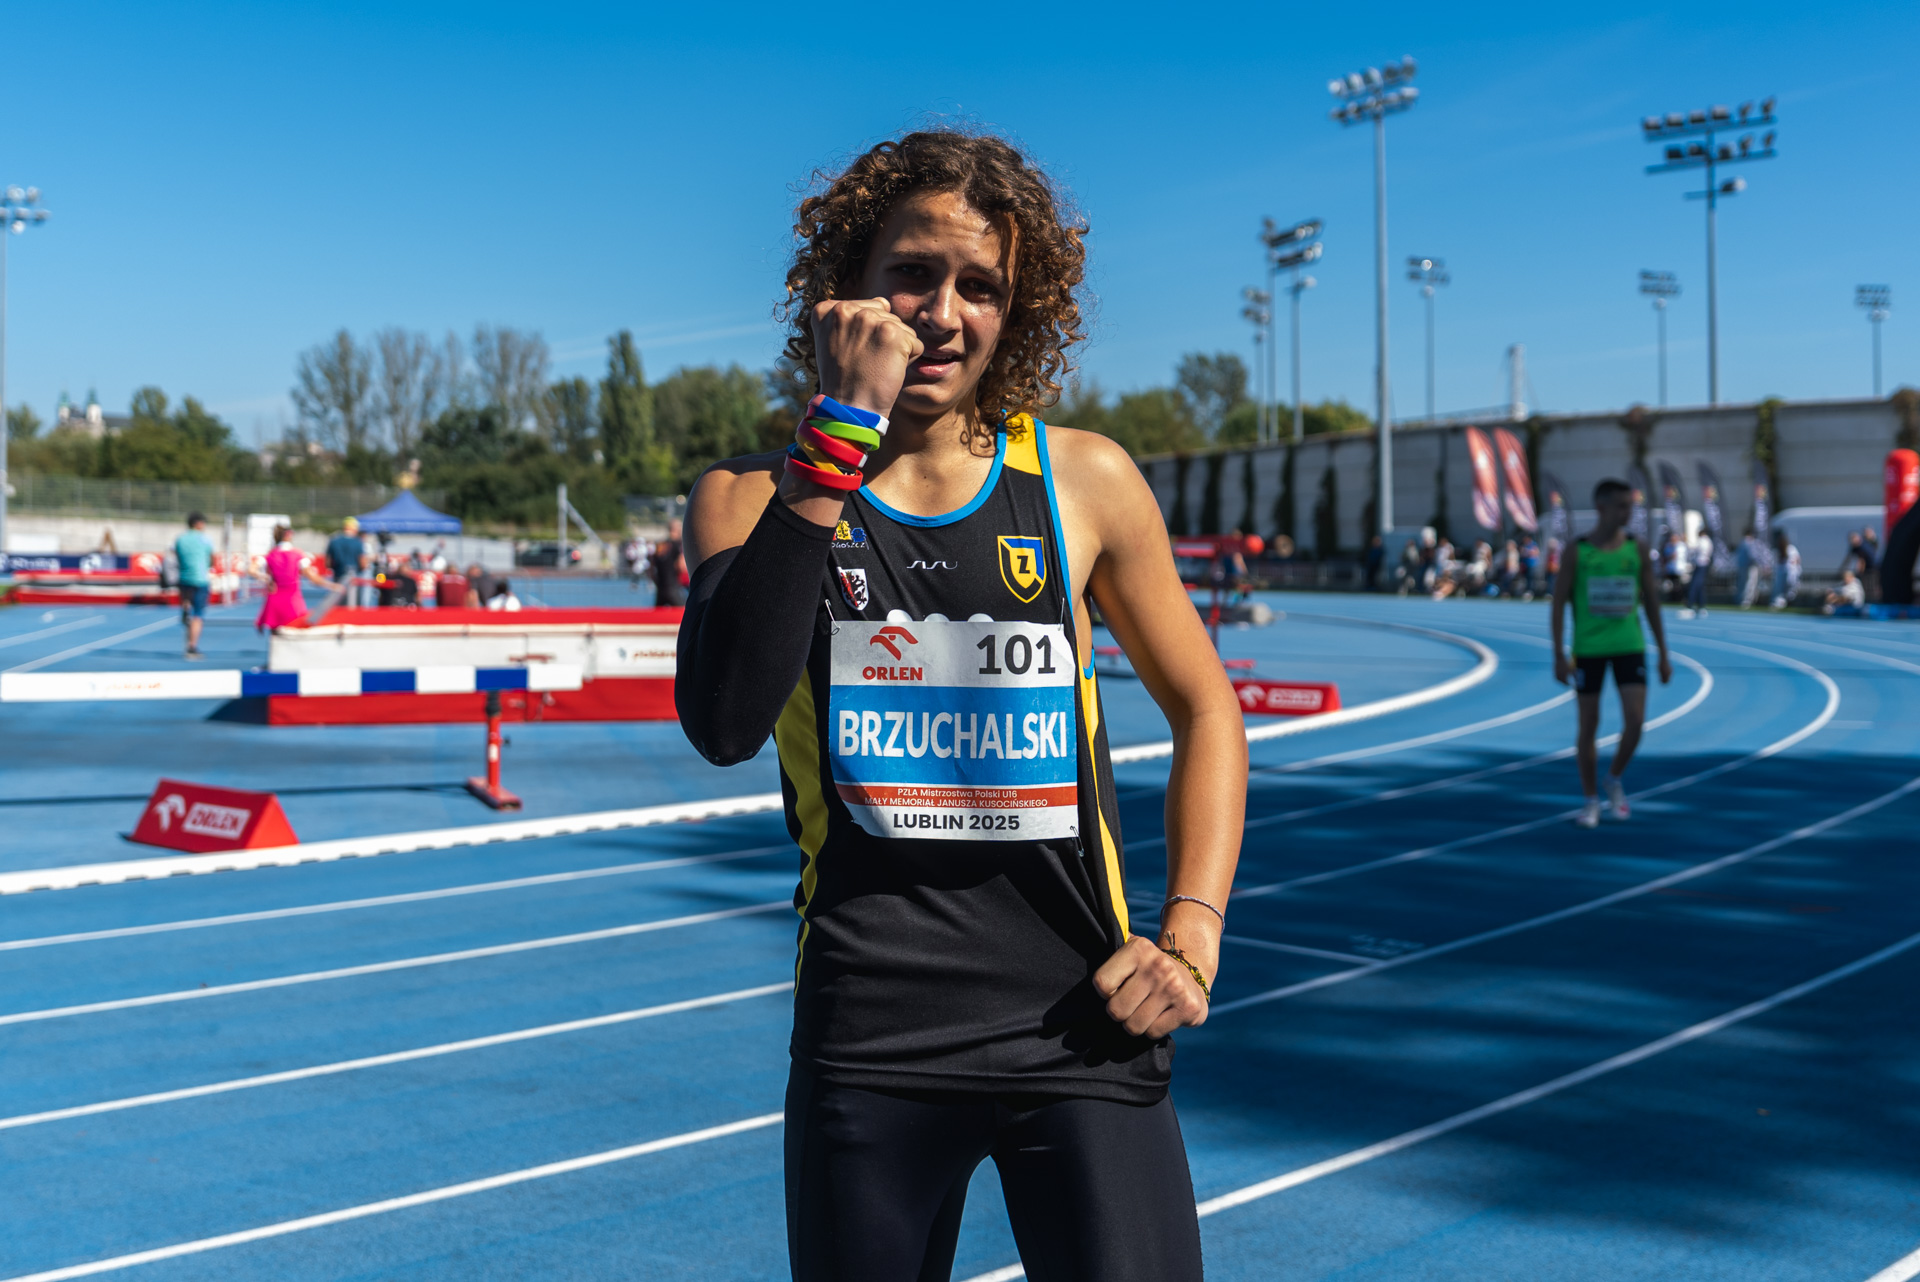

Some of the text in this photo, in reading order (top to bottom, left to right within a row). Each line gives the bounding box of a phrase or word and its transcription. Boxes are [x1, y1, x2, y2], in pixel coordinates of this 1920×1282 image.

[1016, 555, 1031, 574] Z
[976, 634, 1056, 675] 101
[862, 666, 923, 681] ORLEN
[838, 710, 1067, 760] BRZUCHALSKI
[897, 788, 1018, 798] PZLA Mistrzostwa Polski U16
[864, 797, 1048, 808] MAŁY MEMORIAŁ JANUSZA KUSOCIŃSKIEGO
[893, 813, 1020, 830] LUBLIN 2025
